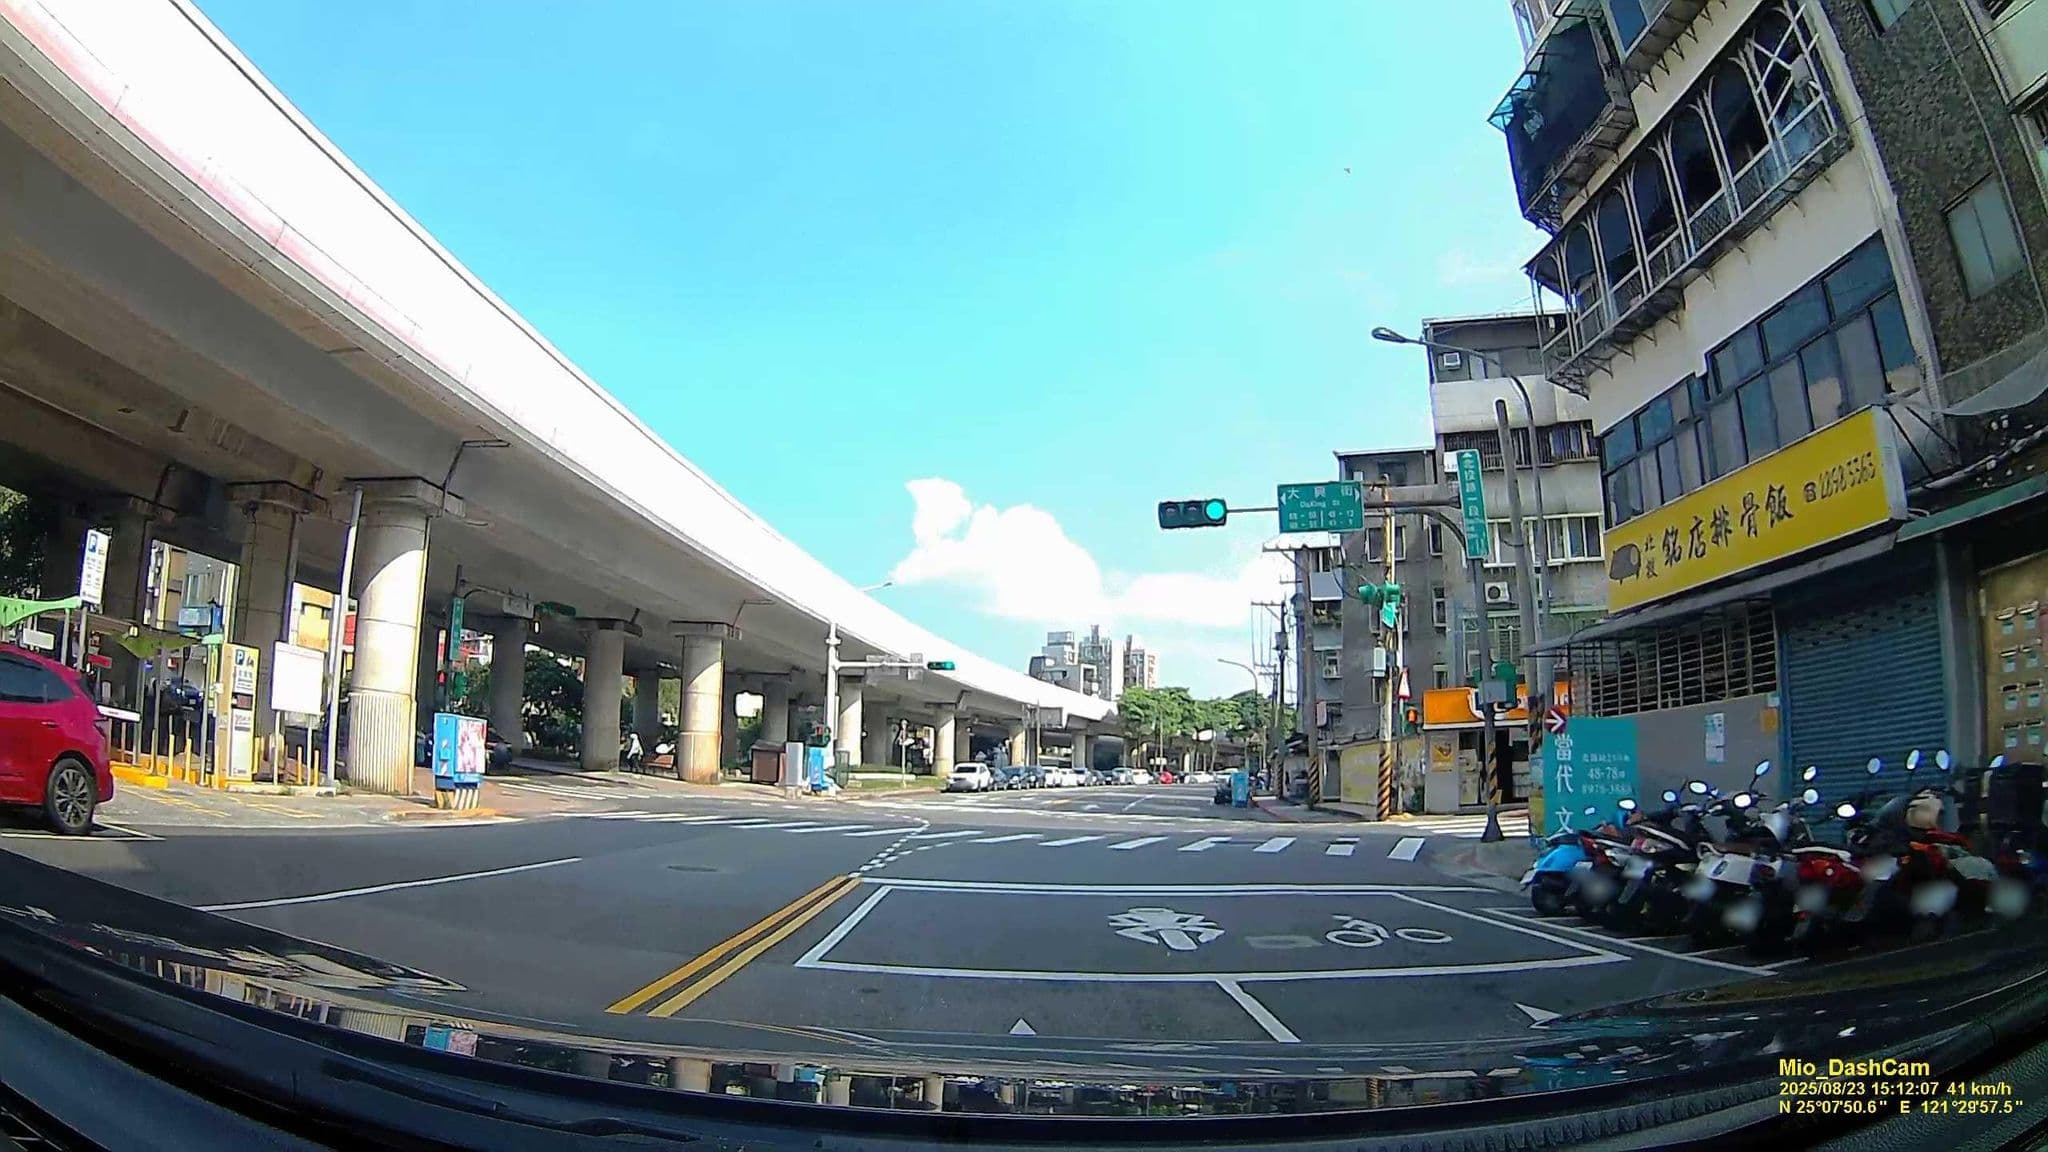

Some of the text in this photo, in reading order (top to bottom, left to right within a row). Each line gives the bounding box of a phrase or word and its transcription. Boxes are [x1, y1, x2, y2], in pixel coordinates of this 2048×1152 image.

[1287, 485, 1353, 500] 大興街
[1661, 483, 1795, 568] 銘店排骨飯
